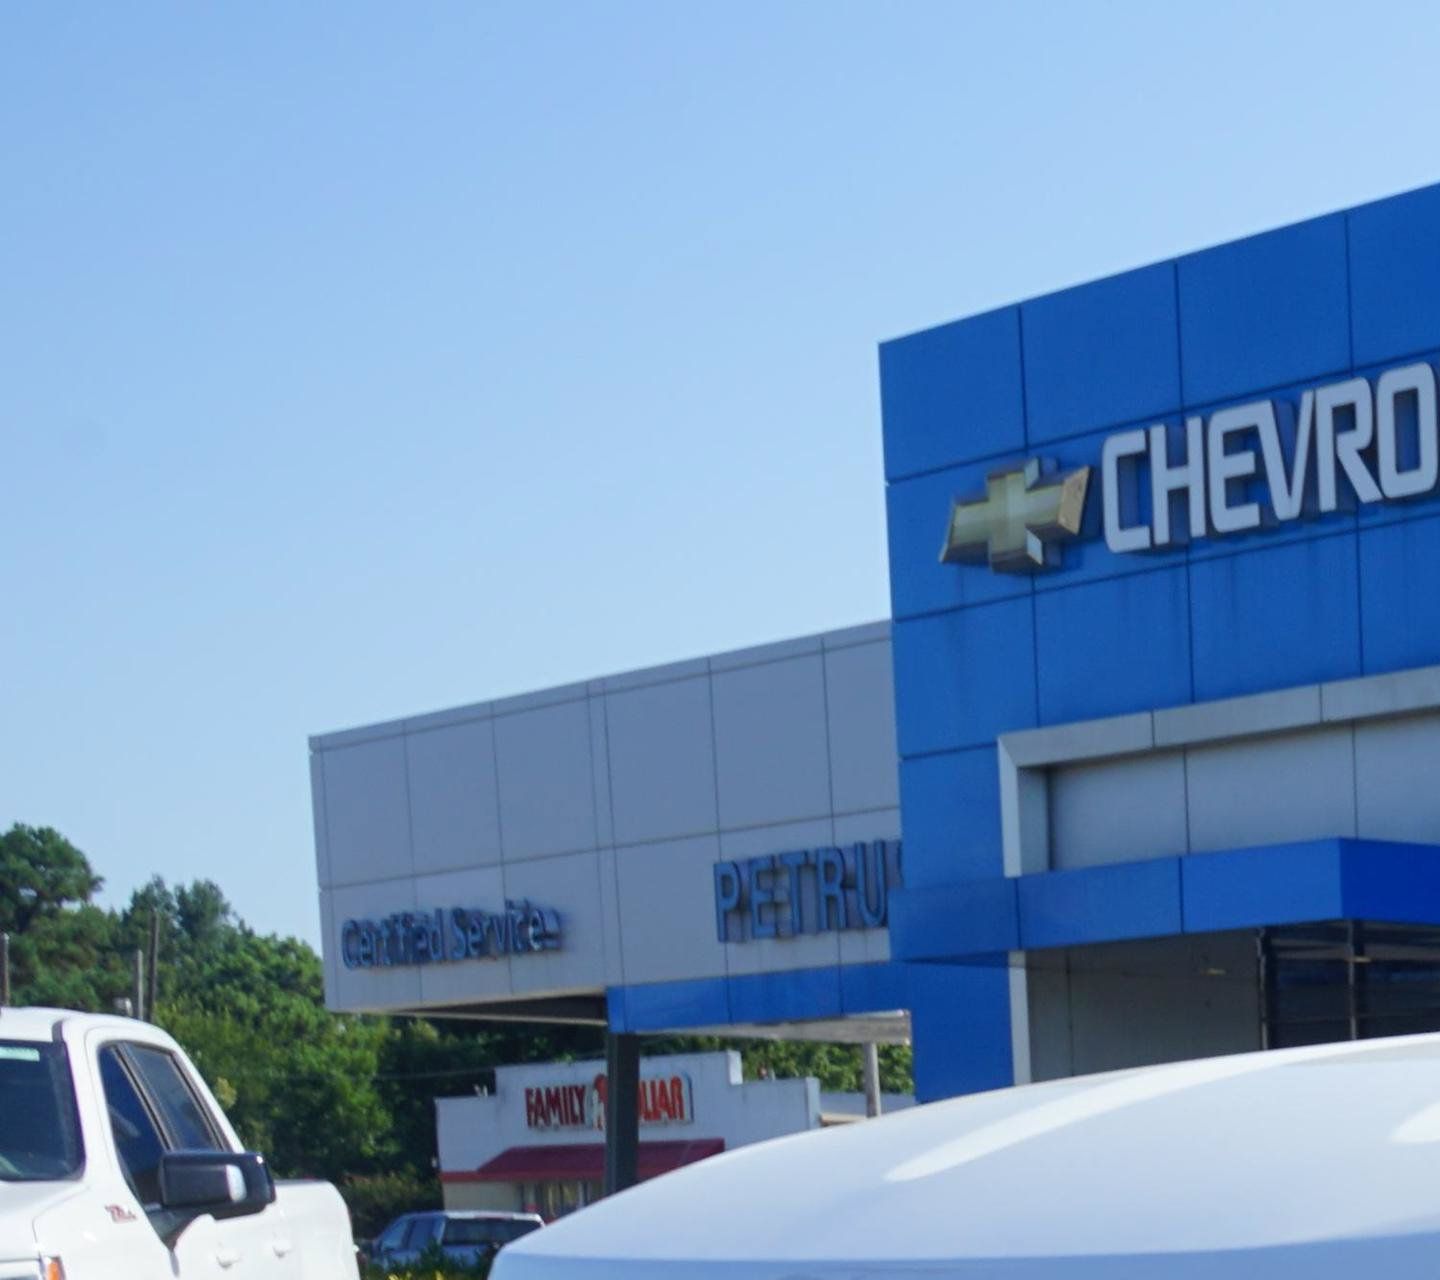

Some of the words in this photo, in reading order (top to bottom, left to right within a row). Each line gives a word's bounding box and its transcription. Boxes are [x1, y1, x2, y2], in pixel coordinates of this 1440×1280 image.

[713, 840, 903, 943] PETRU
[342, 908, 445, 970] Certified
[452, 897, 562, 962] Service
[525, 1085, 587, 1128] FAMILY
